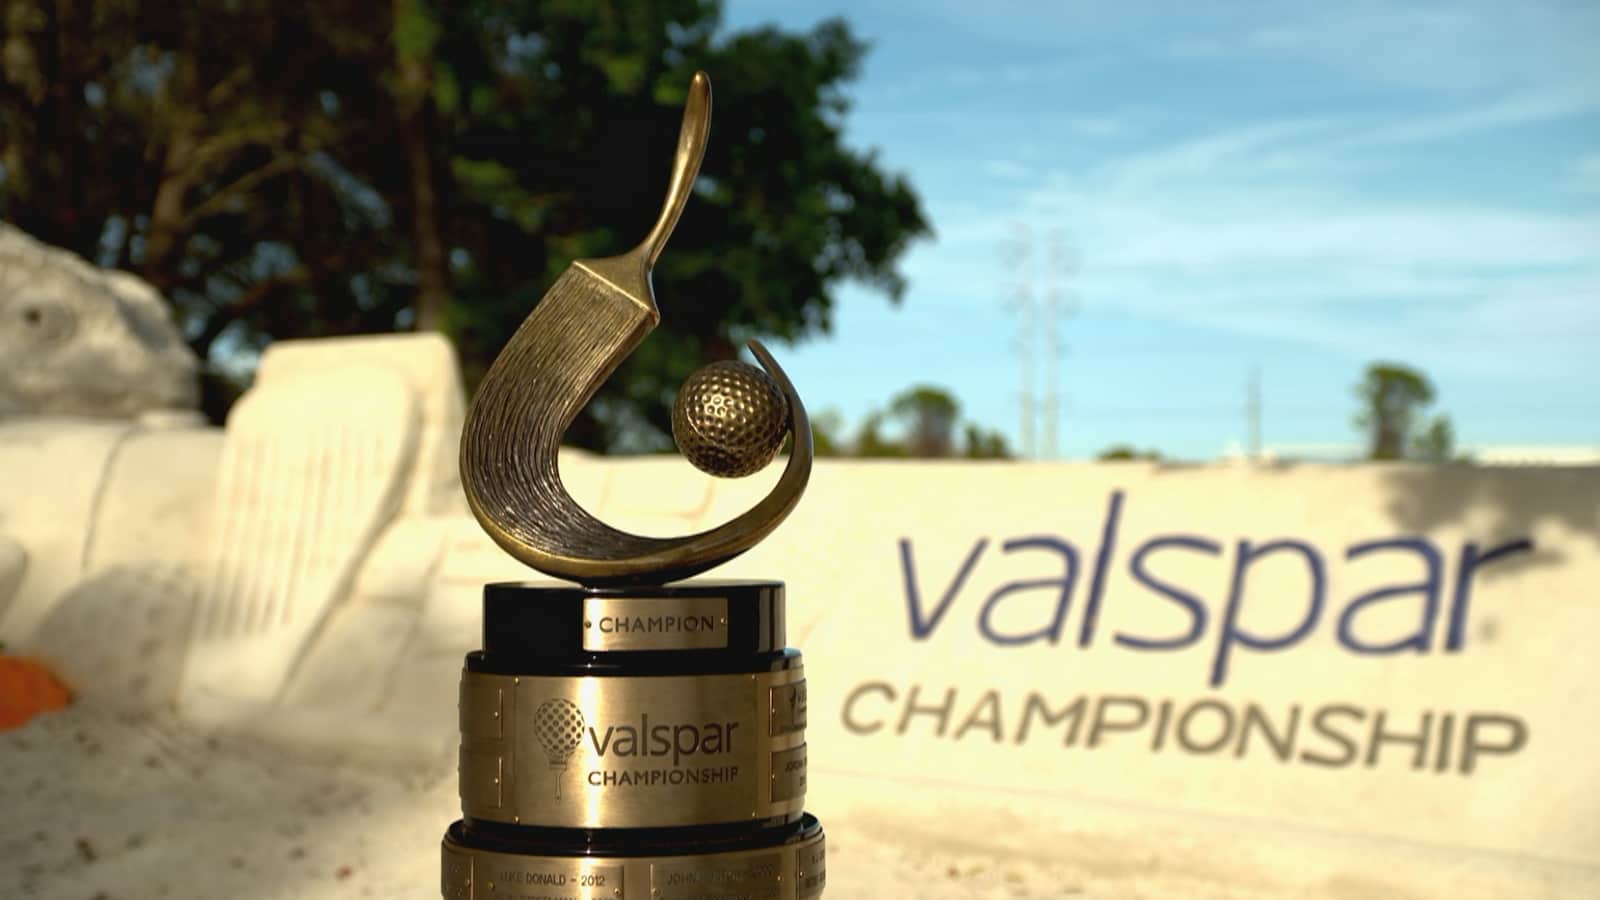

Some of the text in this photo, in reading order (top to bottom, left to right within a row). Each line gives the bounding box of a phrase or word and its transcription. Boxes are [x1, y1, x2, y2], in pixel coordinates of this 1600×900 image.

[898, 489, 1534, 688] valspar
[598, 616, 715, 633] CHAMPION
[588, 714, 740, 766] valspar
[840, 681, 1530, 775] CHAMPIONSHIP
[588, 767, 740, 787] CHAMPIONSHIP
[526, 872, 566, 886] DONALD
[581, 875, 606, 886] 2012
